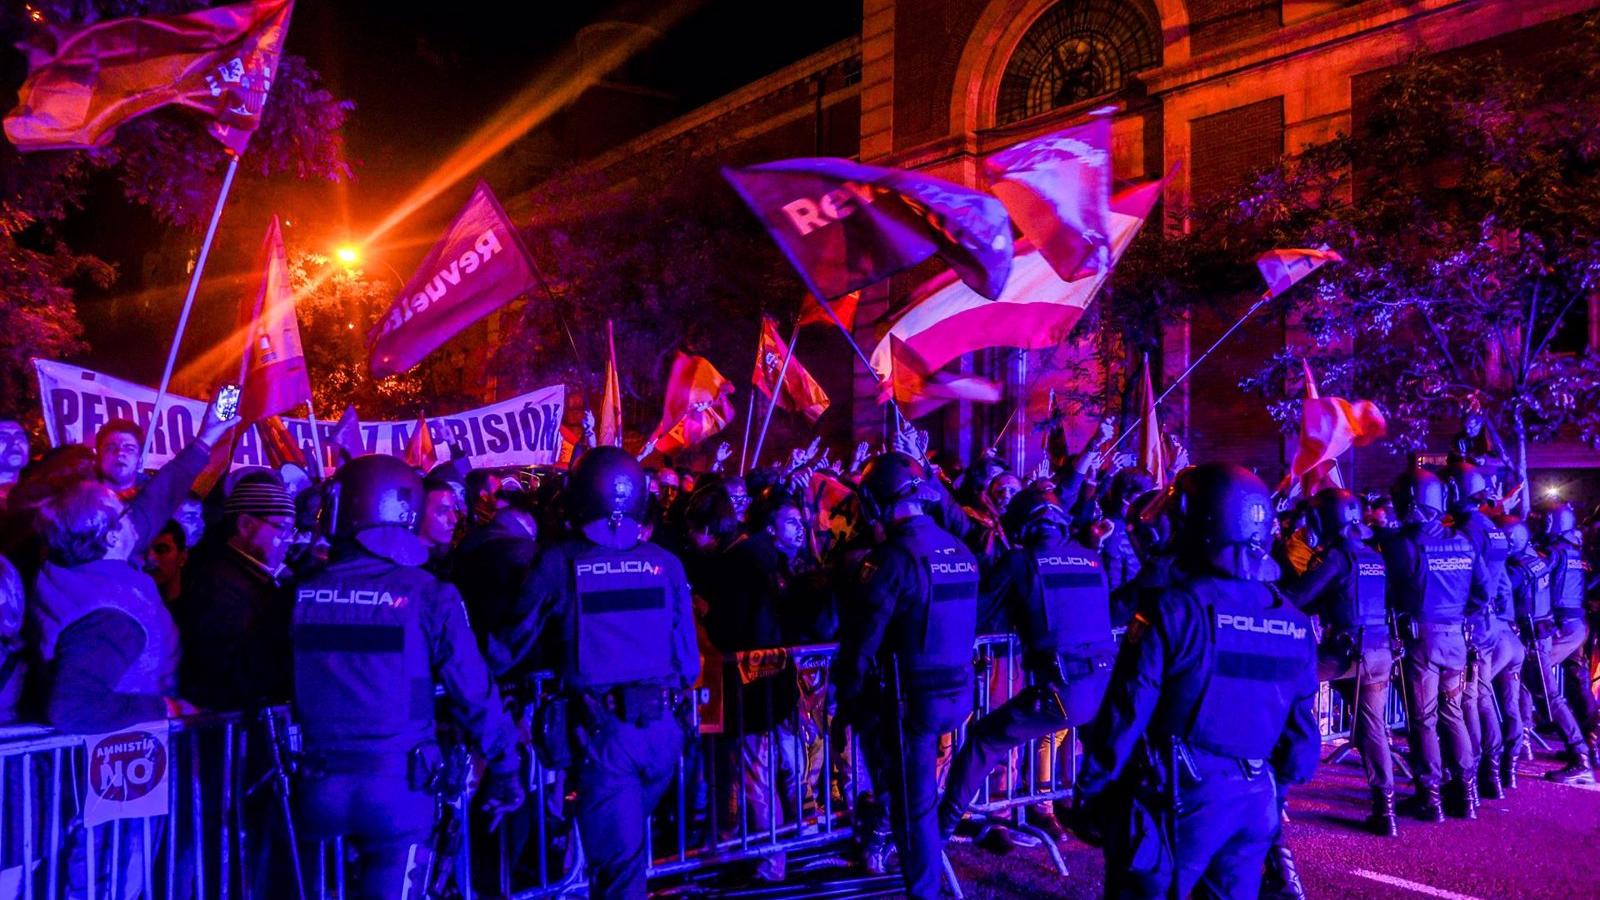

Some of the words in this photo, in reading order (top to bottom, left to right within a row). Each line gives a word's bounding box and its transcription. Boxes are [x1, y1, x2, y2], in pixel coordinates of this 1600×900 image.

[576, 560, 655, 577] POLICIA
[930, 562, 976, 574] POLICIA
[298, 589, 394, 606] POLICIA
[1217, 613, 1295, 637] POLICIA
